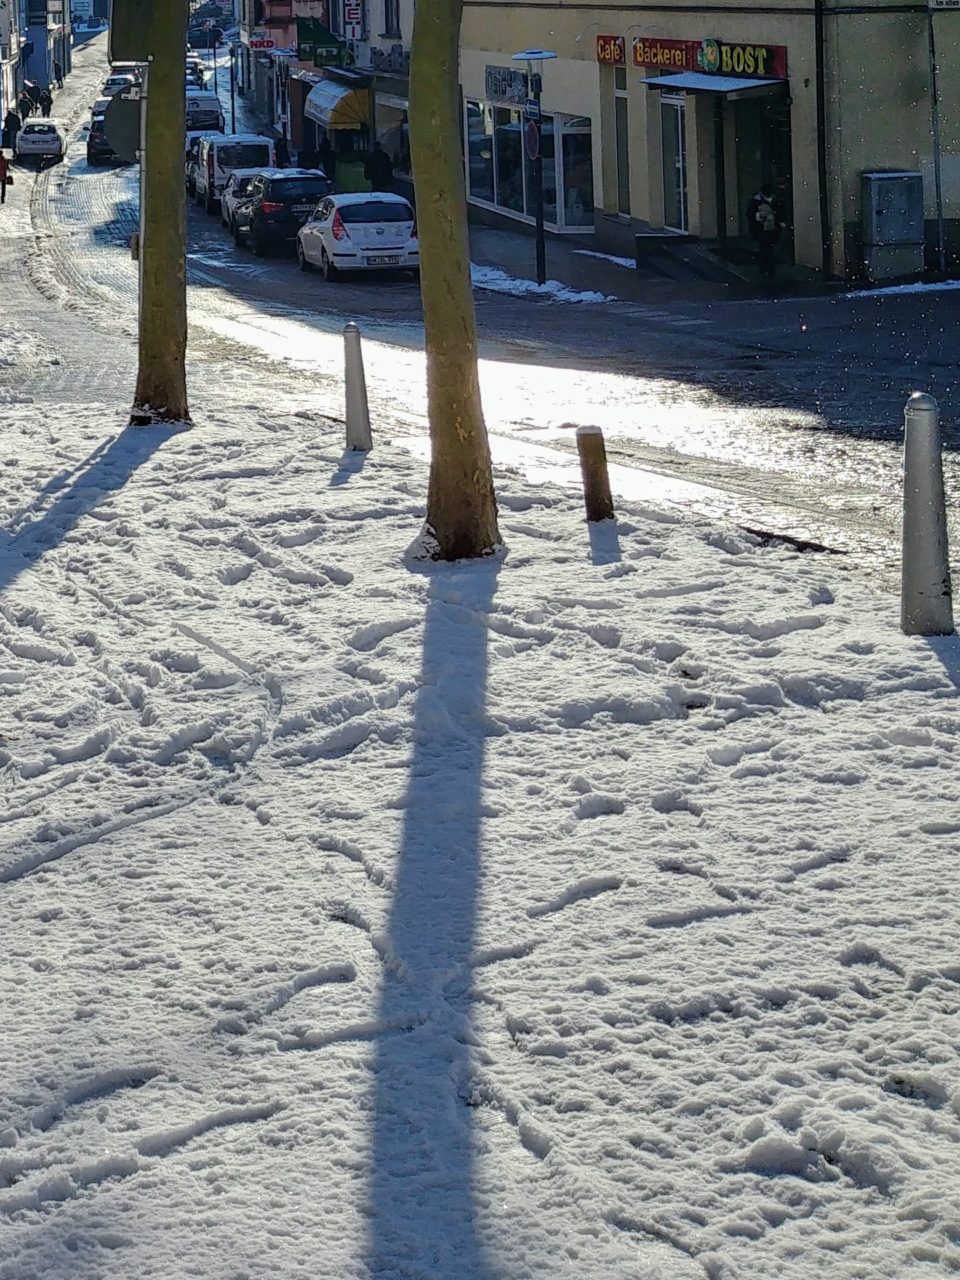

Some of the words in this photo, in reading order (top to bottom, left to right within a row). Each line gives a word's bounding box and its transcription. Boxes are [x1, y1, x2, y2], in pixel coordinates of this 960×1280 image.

[250, 40, 274, 48] NKD
[637, 42, 686, 66] Bäckerei
[722, 45, 767, 74] BOST
